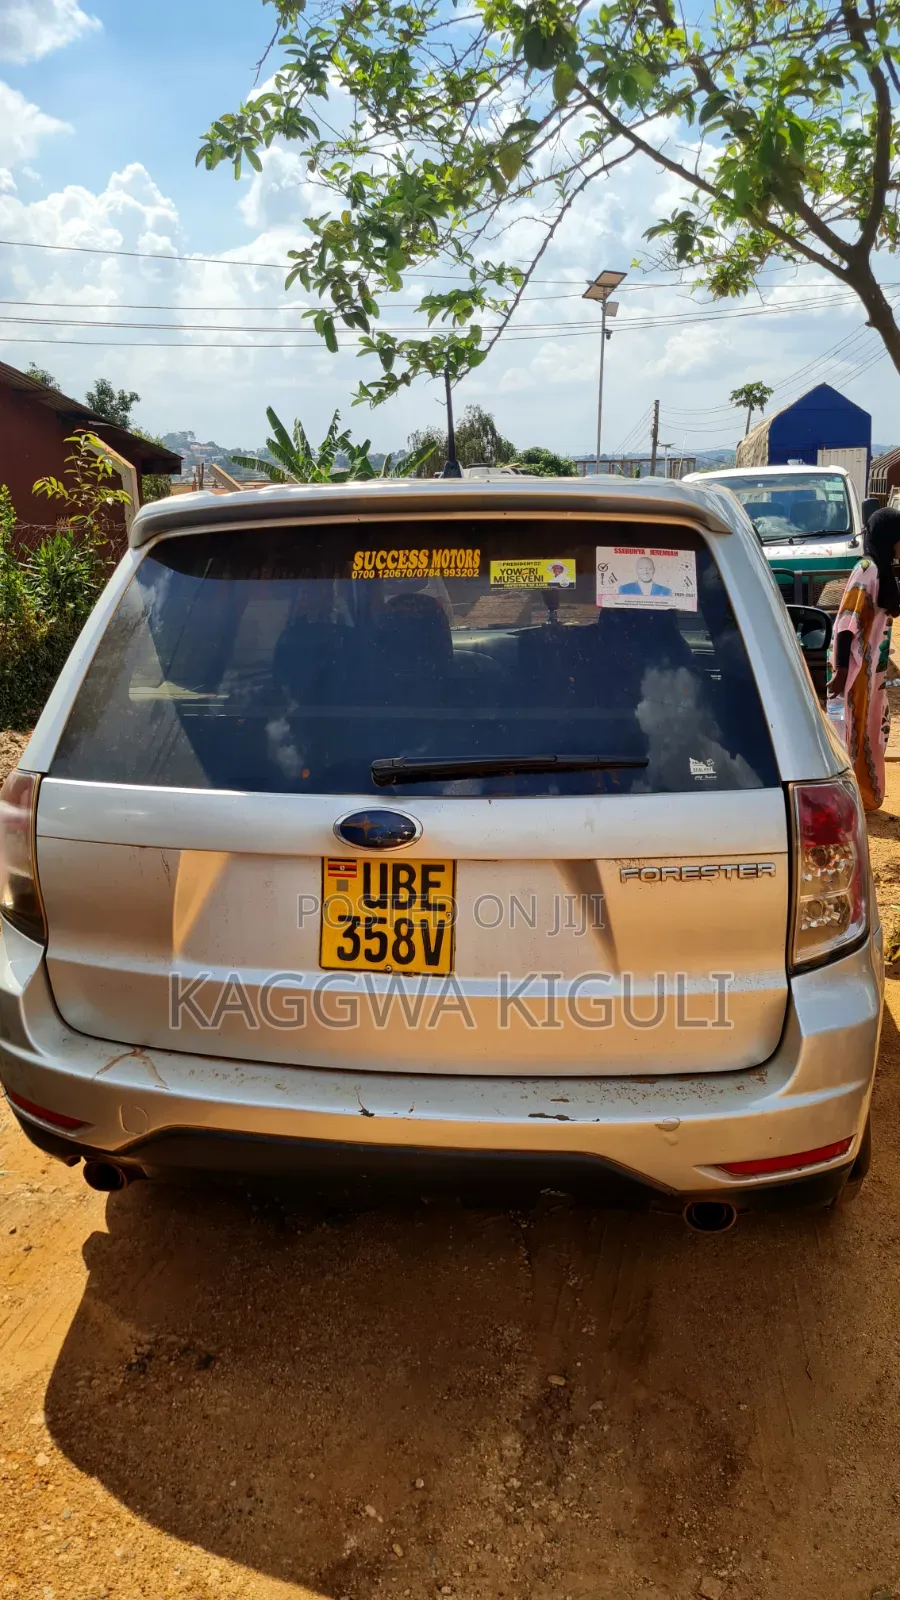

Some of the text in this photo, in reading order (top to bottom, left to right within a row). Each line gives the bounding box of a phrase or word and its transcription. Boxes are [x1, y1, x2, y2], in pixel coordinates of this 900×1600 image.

[352, 549, 480, 570] SUCCESS MOTORS
[351, 568, 479, 579] 0700 120670/0784 993202
[494, 575, 544, 583] MUSEVENI
[620, 862, 777, 883] FORESTER
[363, 862, 446, 911] UBE
[337, 914, 446, 966] 358V
